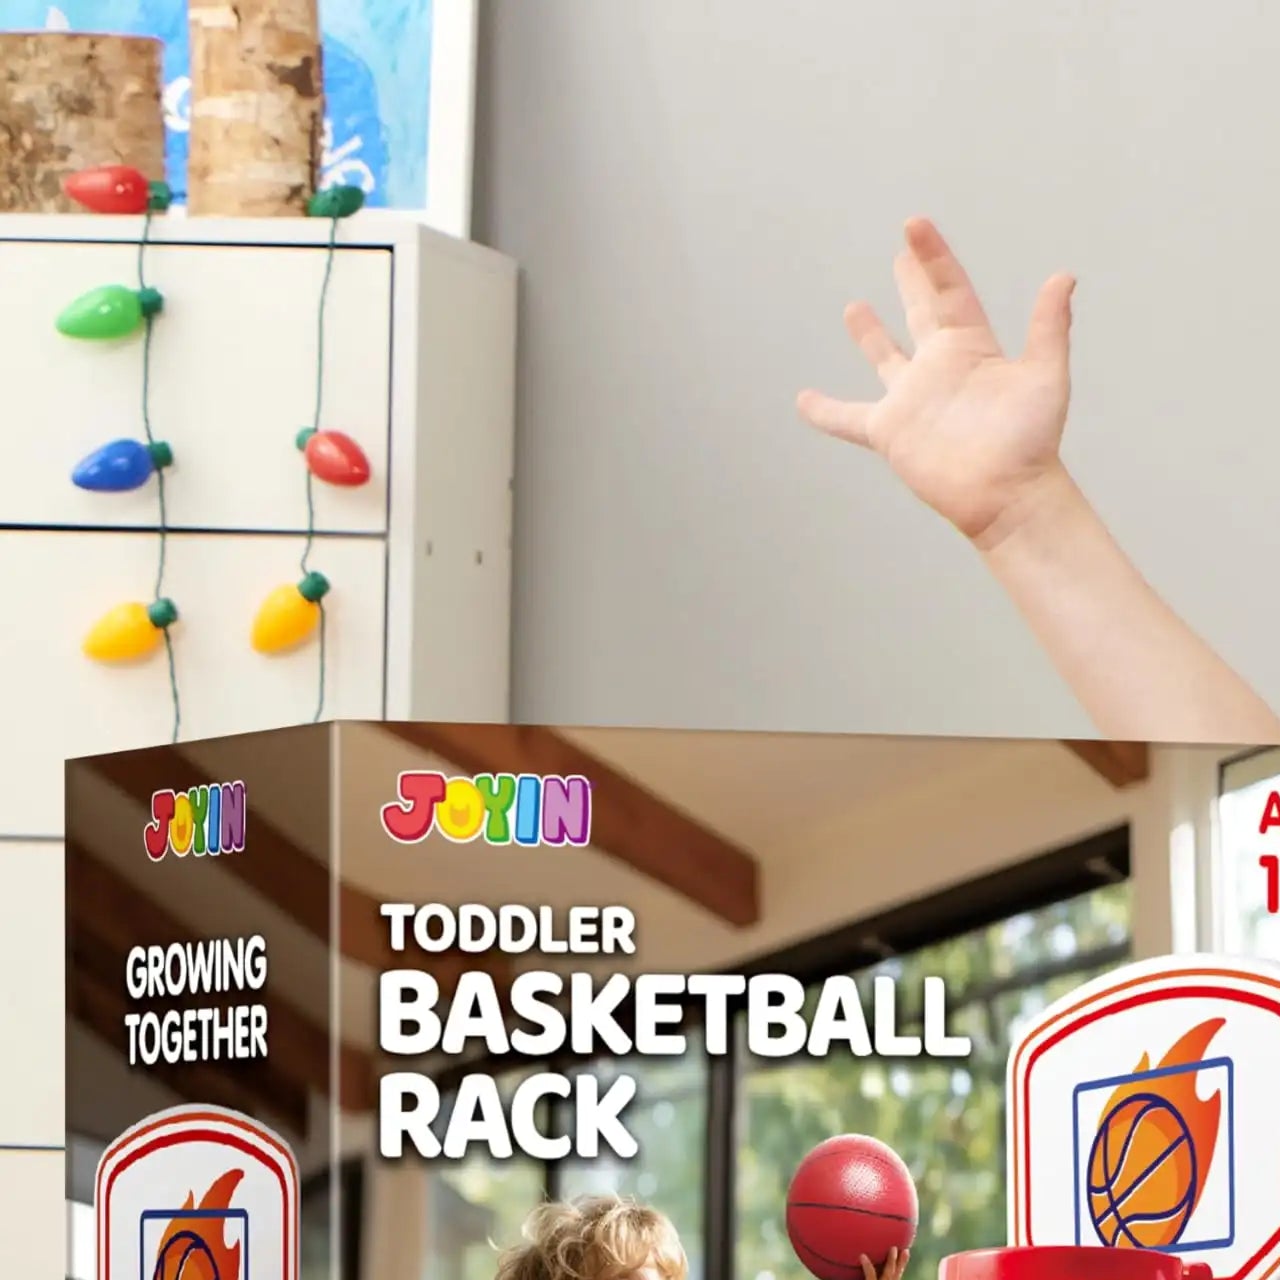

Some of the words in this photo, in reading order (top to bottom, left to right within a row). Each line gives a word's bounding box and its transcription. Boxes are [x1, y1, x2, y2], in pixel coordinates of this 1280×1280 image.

[144, 781, 247, 861] JOYIN
[381, 770, 592, 847] JOYIN
[126, 935, 267, 999] GROWING
[380, 903, 636, 954] TODDLER
[125, 1004, 268, 1065] TOGETHER
[380, 969, 971, 1057] BASKETBALL
[380, 1072, 638, 1160] RACK
